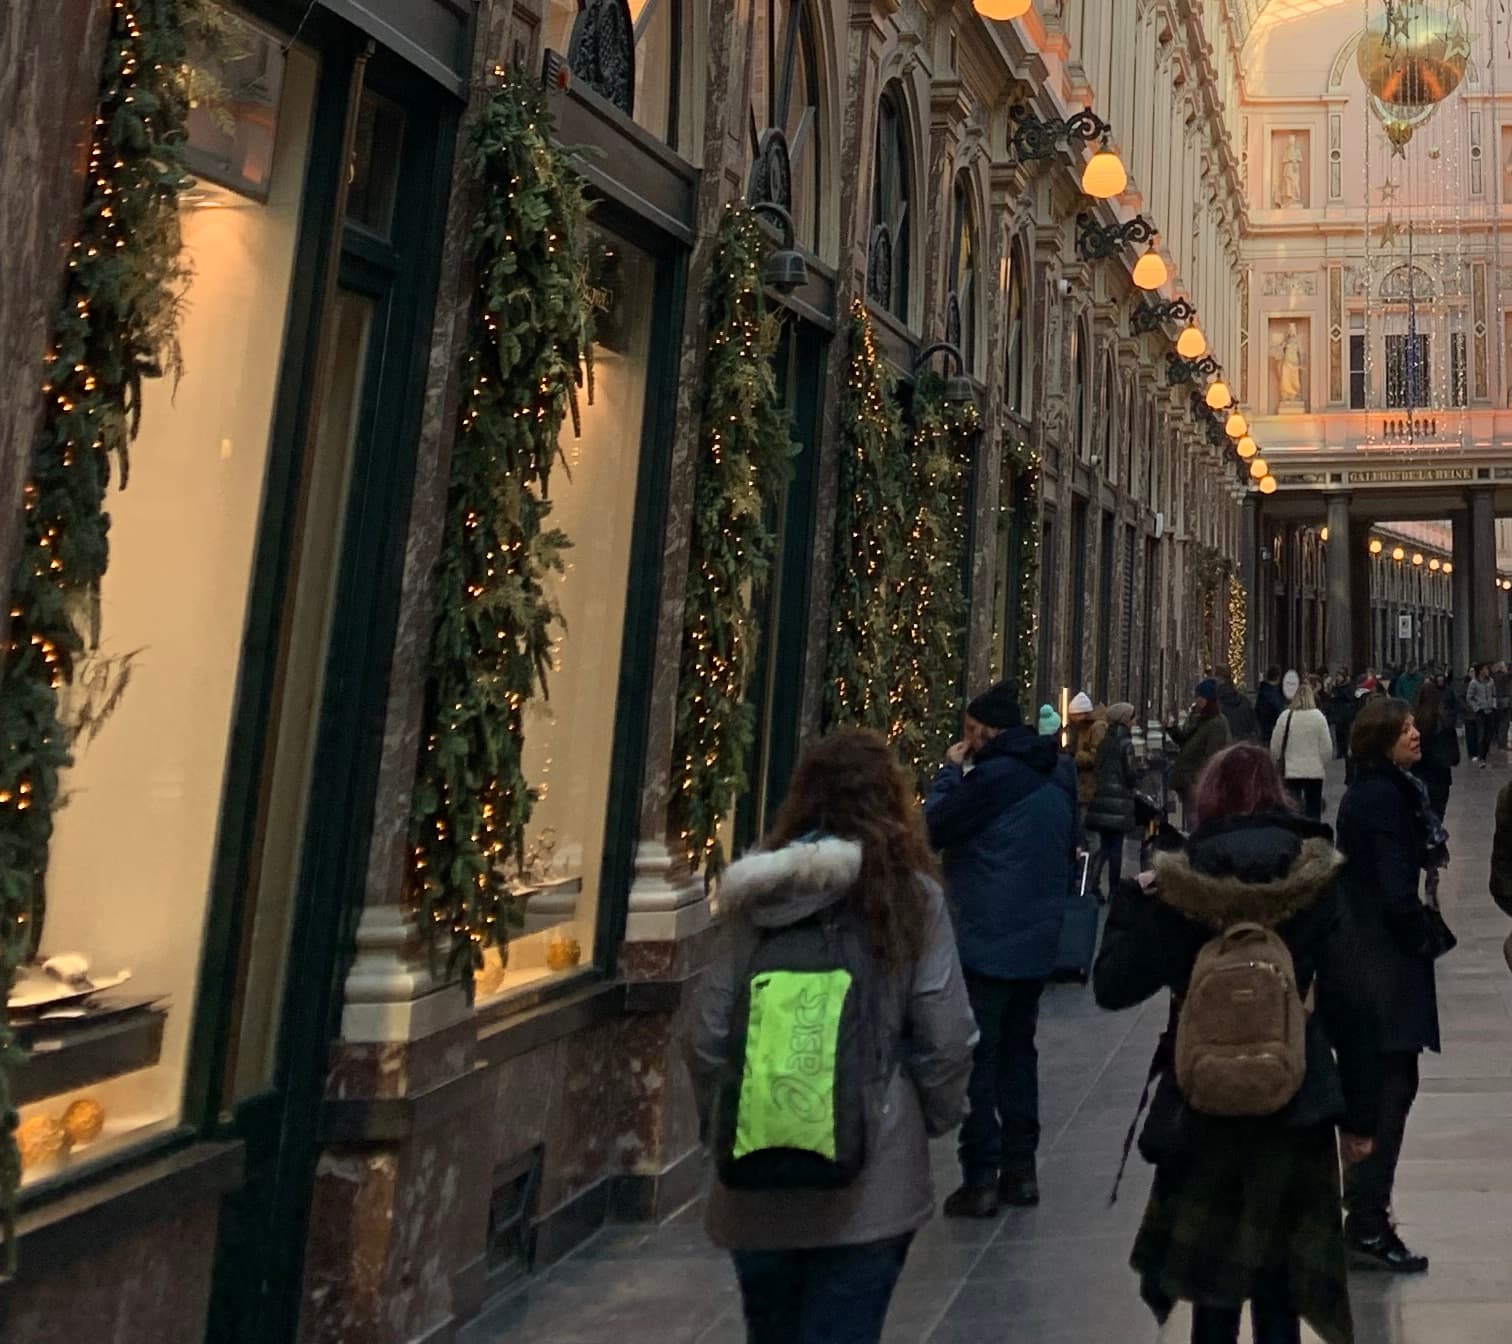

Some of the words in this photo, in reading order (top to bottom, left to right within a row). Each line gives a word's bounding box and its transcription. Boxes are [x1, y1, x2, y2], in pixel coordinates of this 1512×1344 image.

[1349, 471, 1400, 482] GALERIE
[1401, 470, 1418, 481] DE
[1419, 470, 1435, 481] LA
[1435, 468, 1472, 480] REINE
